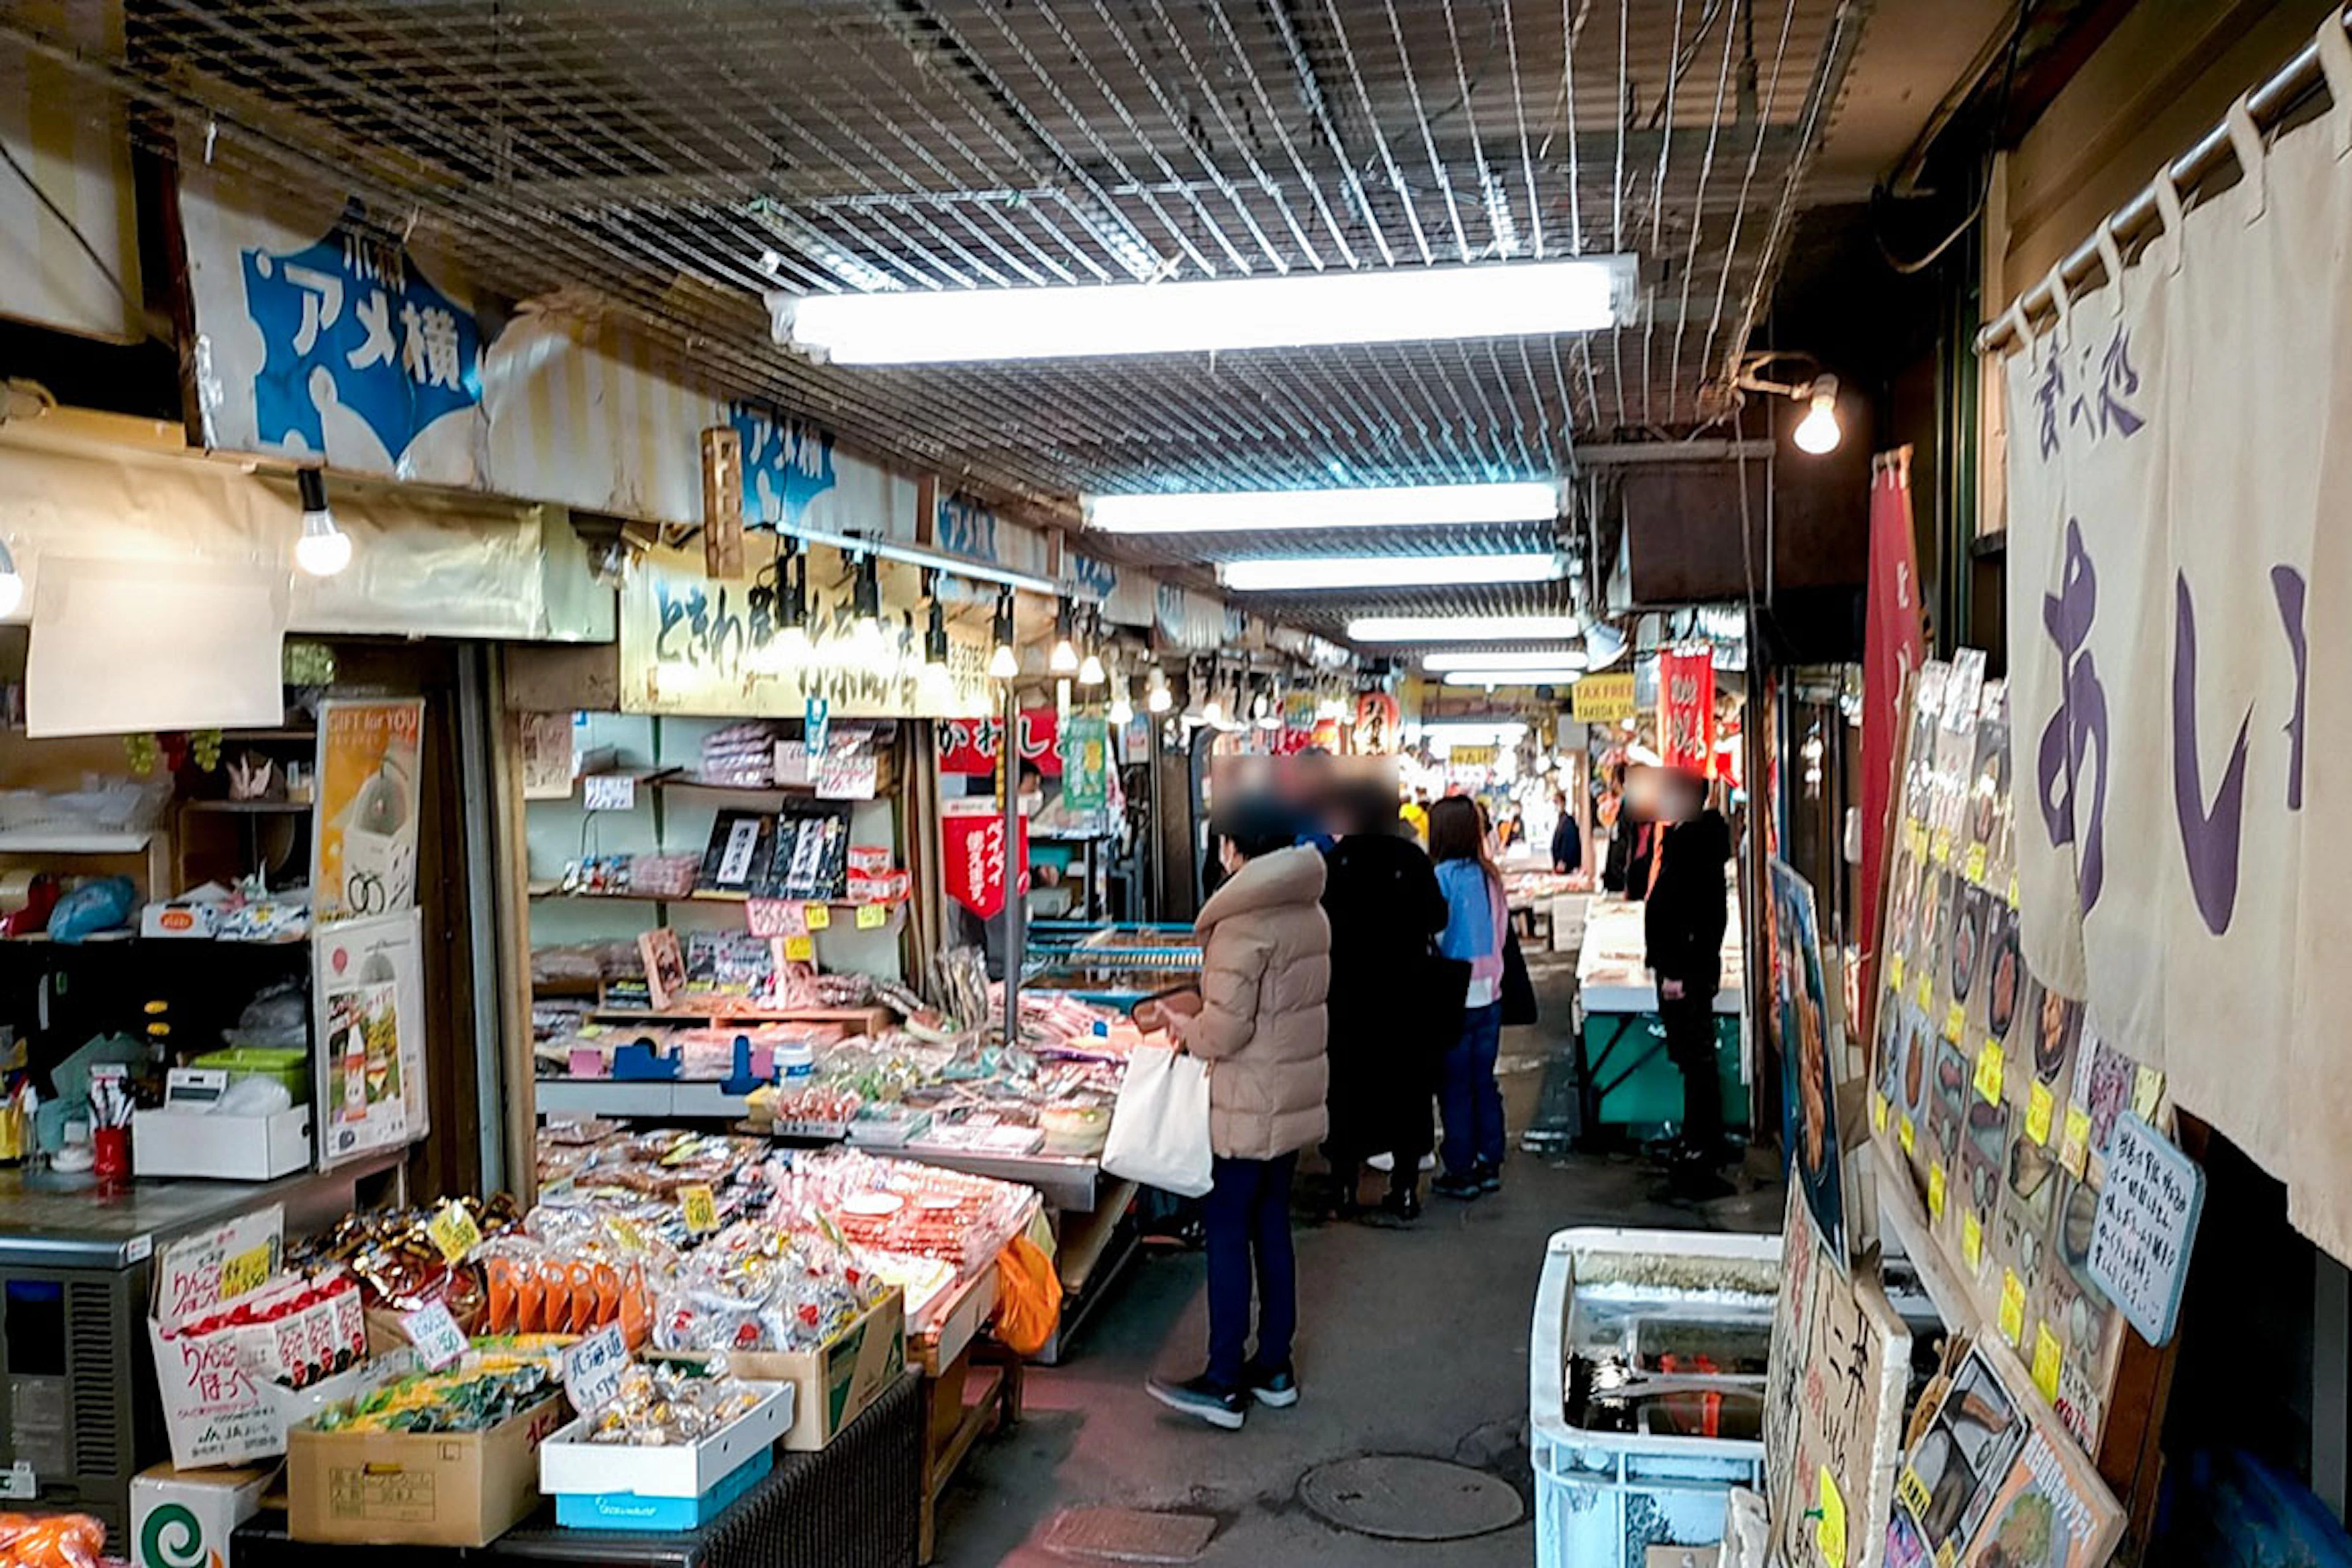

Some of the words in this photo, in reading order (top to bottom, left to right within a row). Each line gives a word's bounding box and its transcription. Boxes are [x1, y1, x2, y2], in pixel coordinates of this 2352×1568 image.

[283, 262, 461, 391] アメ横
[385, 706, 418, 737] YOU
[571, 1327, 627, 1383] 北海道
